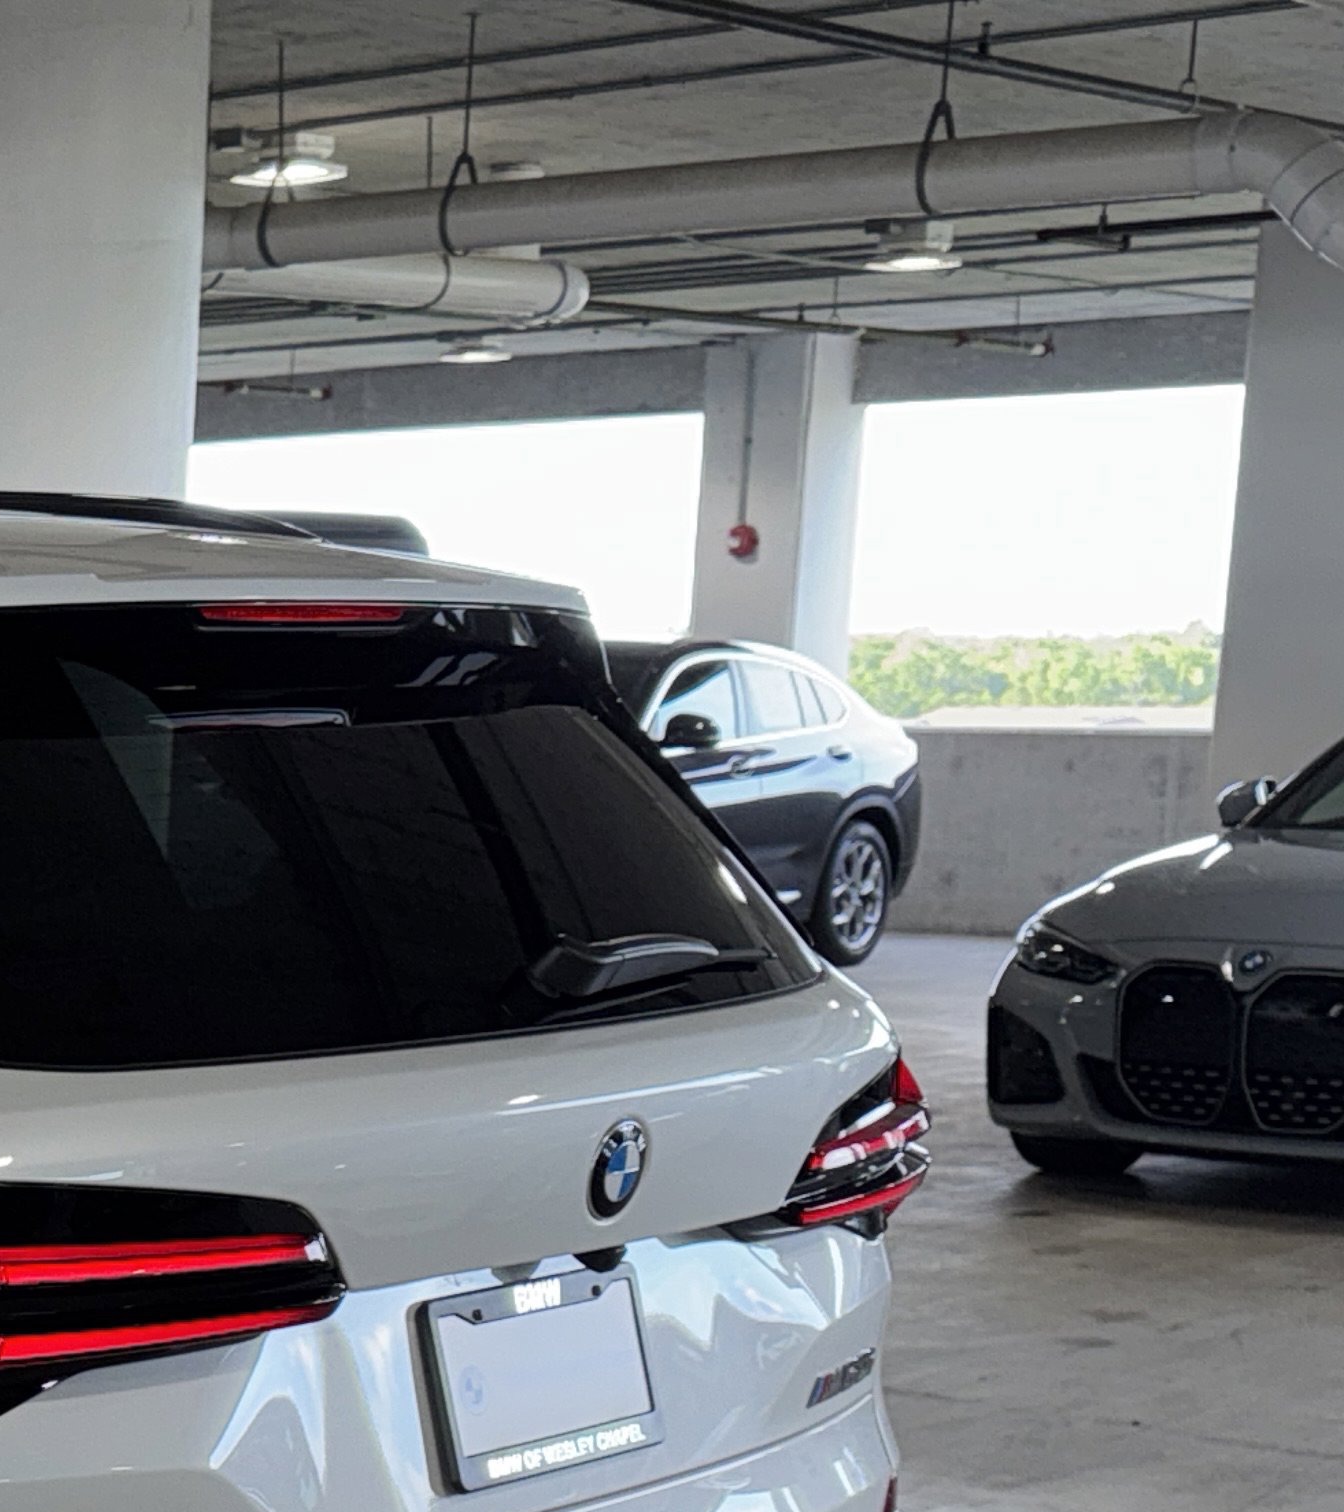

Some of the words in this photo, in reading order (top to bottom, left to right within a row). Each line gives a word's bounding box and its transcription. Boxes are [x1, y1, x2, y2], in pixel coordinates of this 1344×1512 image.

[513, 1277, 561, 1314] BMW
[487, 1453, 523, 1479] BMW
[523, 1448, 543, 1470] OF
[542, 1435, 595, 1465] WESLEY
[596, 1423, 647, 1451] CHAPEL
